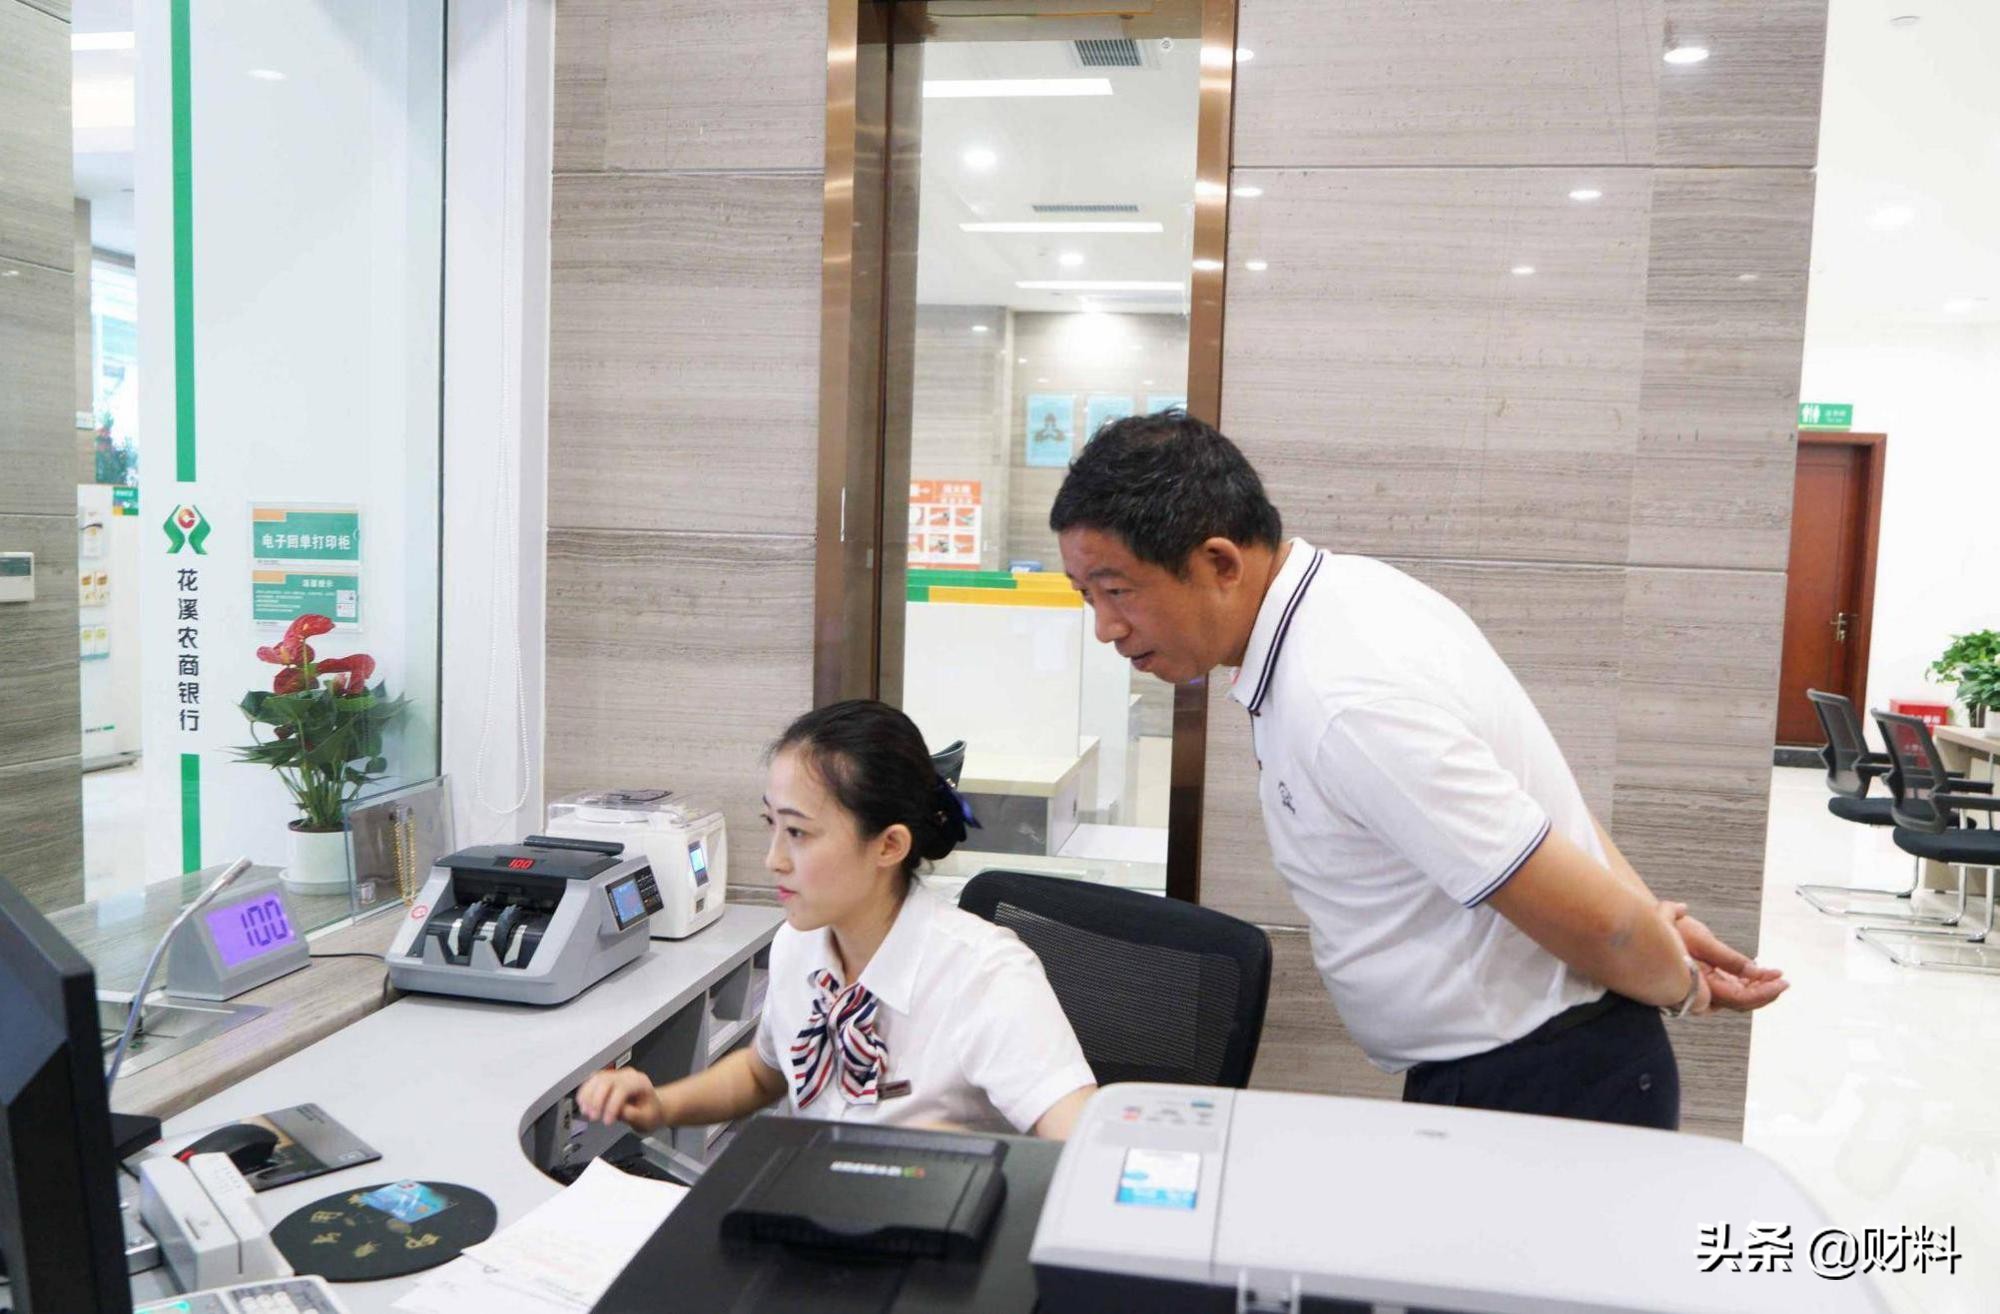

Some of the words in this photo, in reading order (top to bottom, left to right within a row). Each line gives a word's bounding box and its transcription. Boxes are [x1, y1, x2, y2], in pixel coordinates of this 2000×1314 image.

[262, 534, 351, 550] 电子回单打印柜
[177, 568, 200, 732] 花溪农商银行
[509, 858, 533, 870] 100
[241, 899, 288, 947] 100
